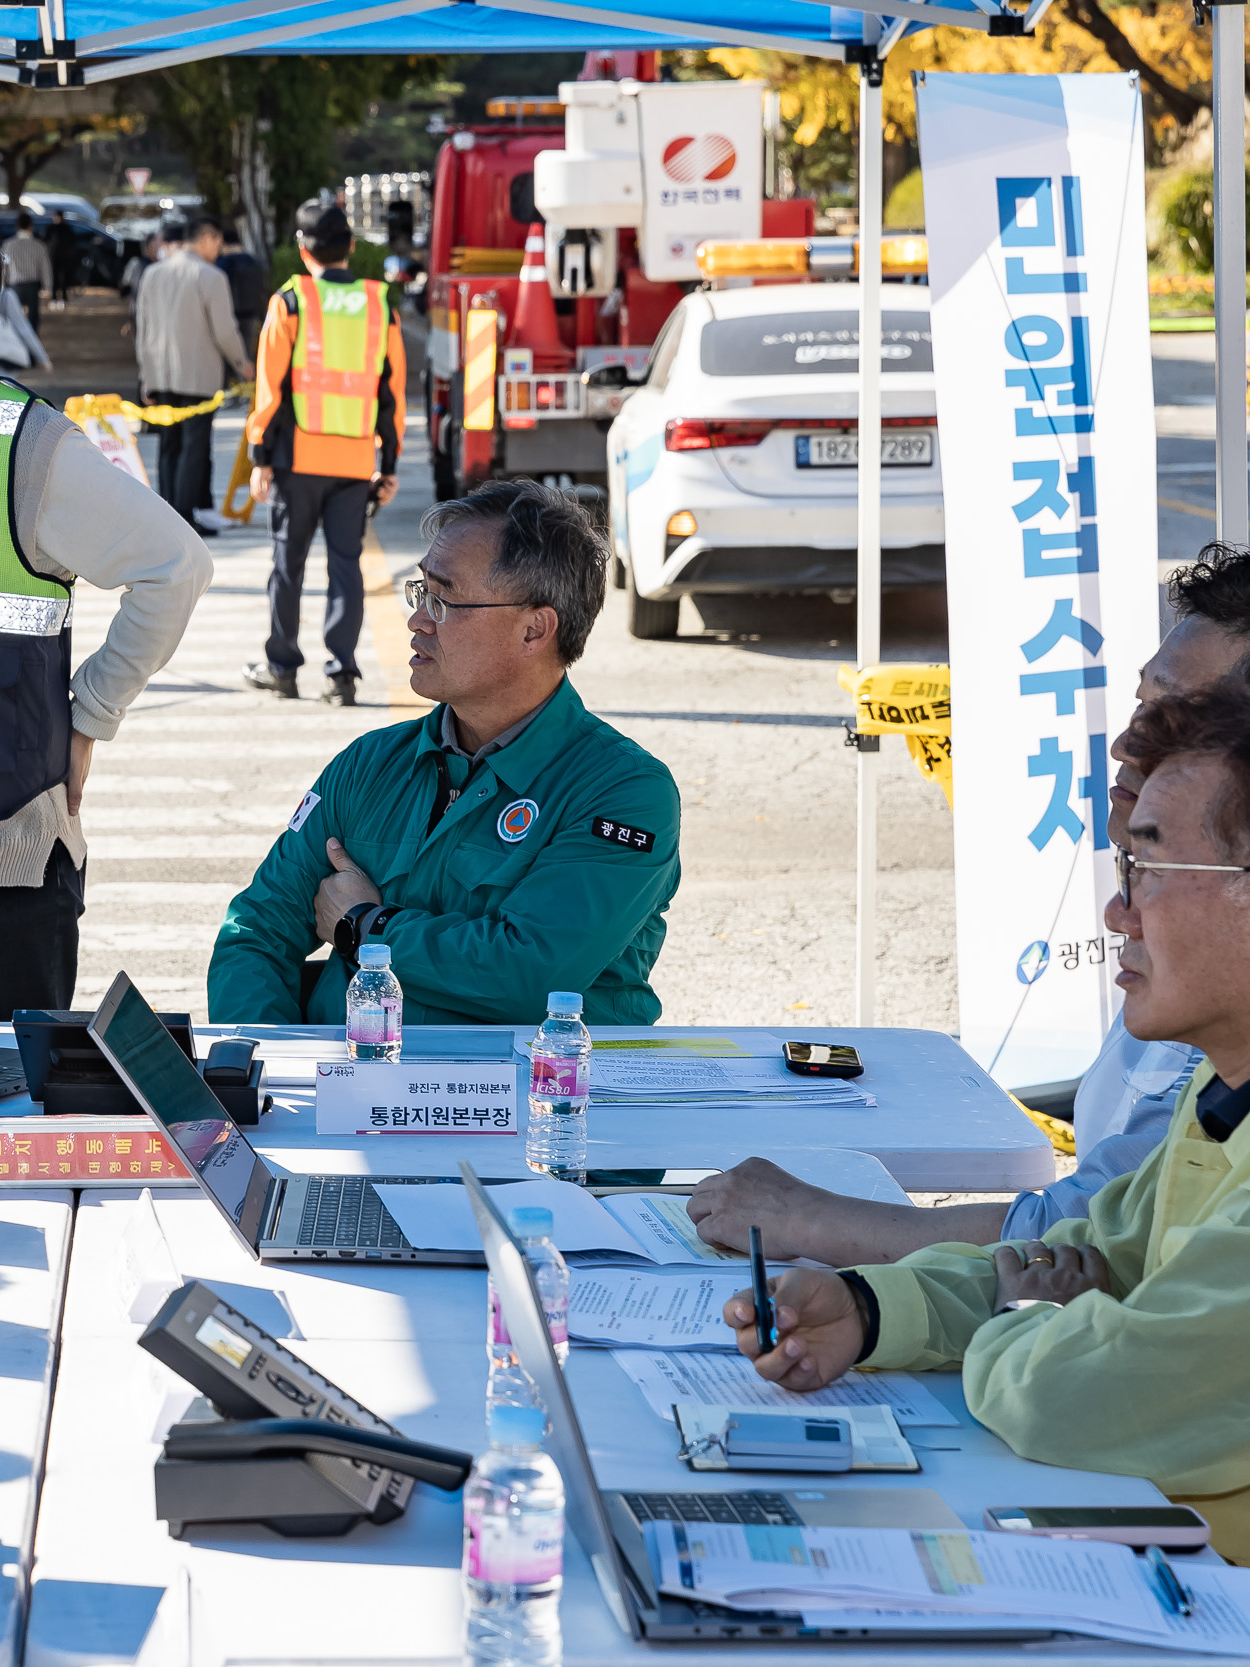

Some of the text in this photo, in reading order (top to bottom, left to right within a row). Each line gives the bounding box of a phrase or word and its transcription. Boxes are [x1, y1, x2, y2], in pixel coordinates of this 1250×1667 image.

[323, 287, 368, 315] 119
[996, 175, 1111, 853] 민원접수처
[601, 821, 647, 847] 광진구
[1058, 934, 1127, 971] 광진구
[408, 1082, 512, 1095] 광진구 통합지원본부
[369, 1105, 512, 1128] 통합지원본부장
[56, 1138, 162, 1156] 행동매뉴
